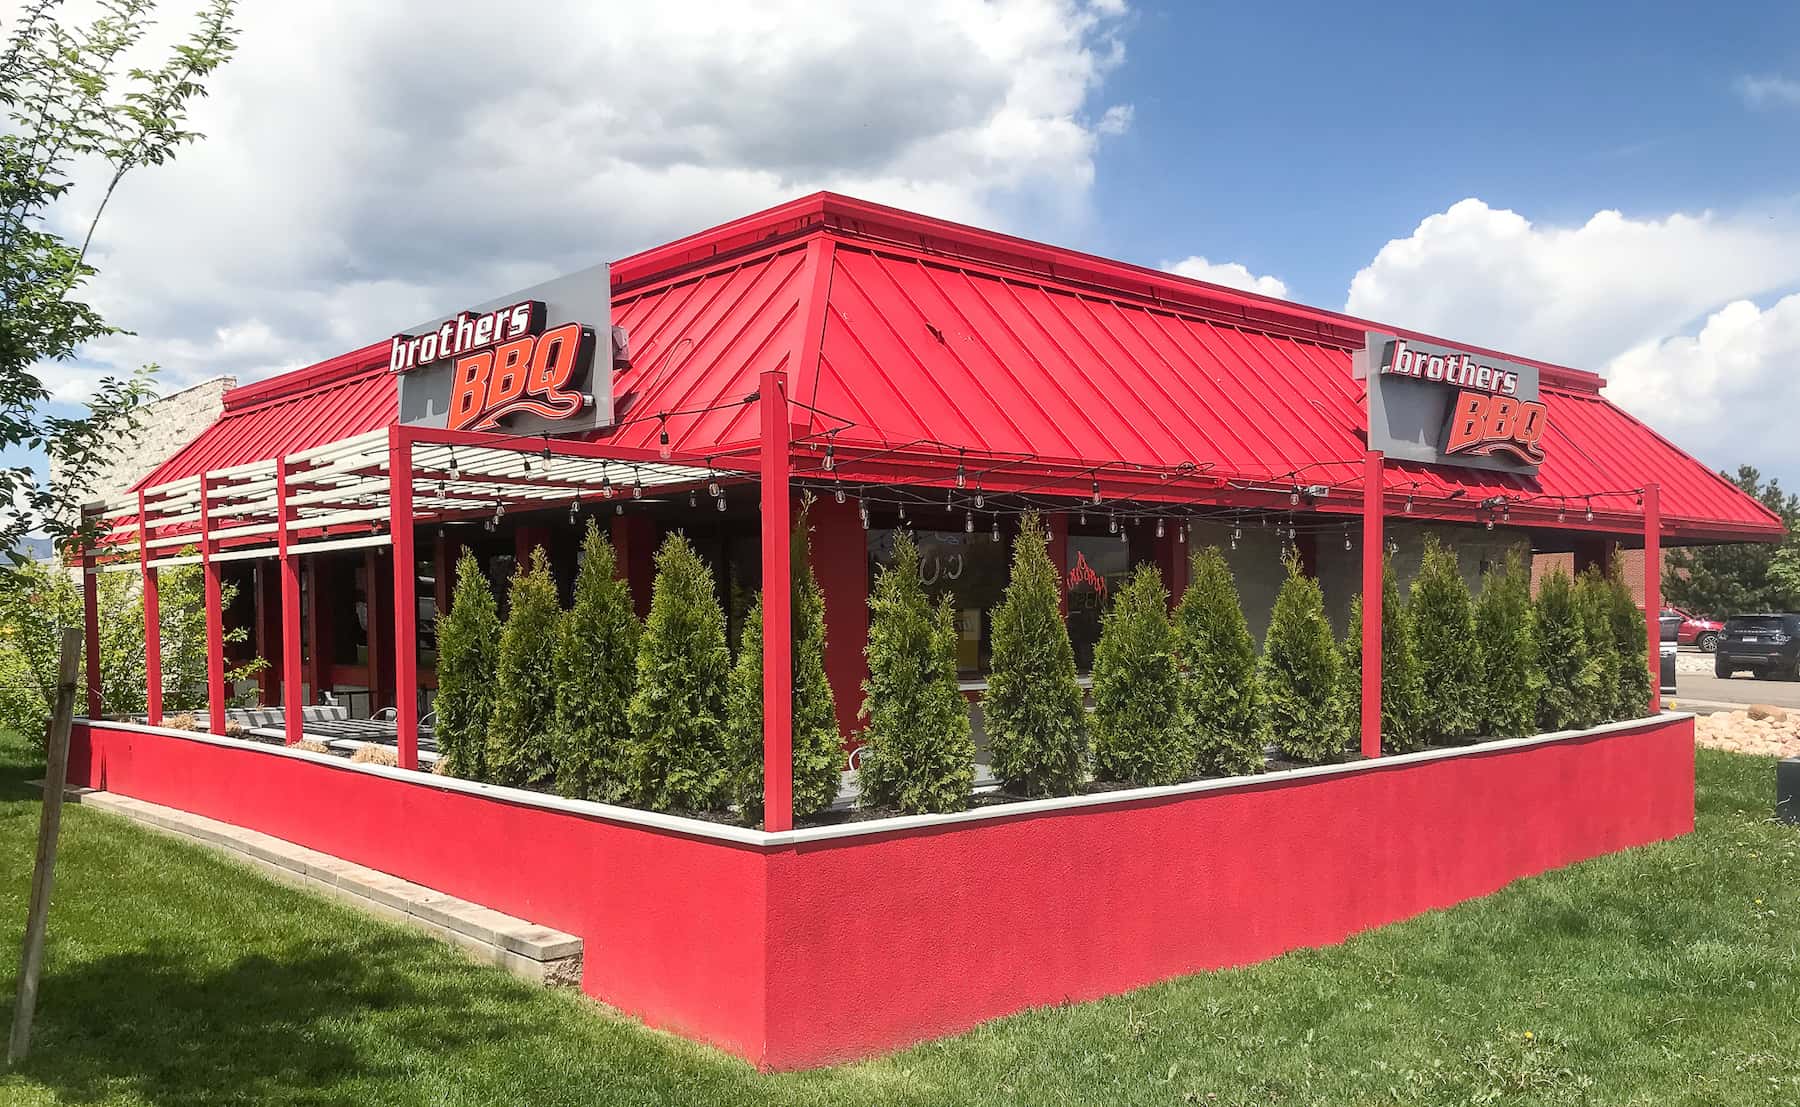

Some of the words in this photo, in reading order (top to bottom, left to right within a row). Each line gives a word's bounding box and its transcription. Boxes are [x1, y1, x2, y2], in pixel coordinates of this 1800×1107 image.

[389, 302, 531, 373] brothers
[1394, 340, 1518, 395] brothers
[448, 323, 583, 430] BBQ
[1446, 389, 1547, 465] BBQ
